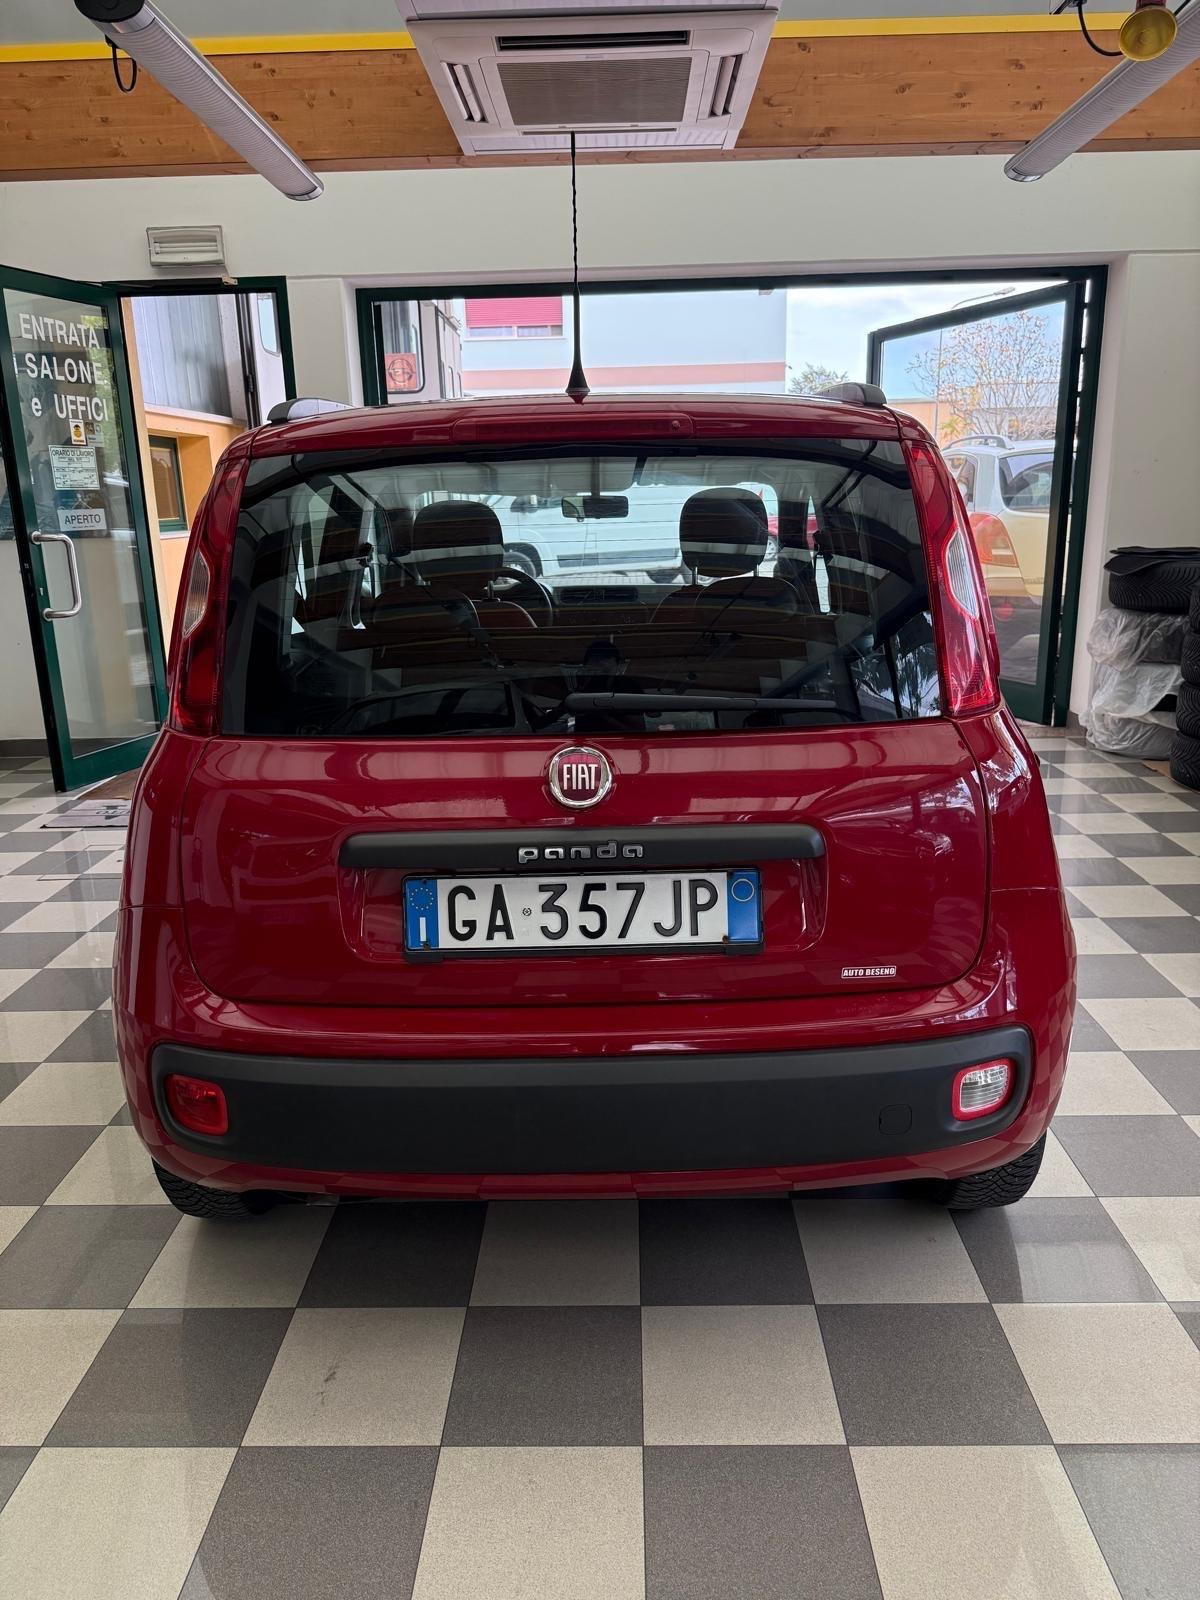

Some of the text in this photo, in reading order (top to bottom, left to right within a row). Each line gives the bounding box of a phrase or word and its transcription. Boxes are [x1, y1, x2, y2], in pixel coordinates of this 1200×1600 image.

[19, 313, 100, 349] ENTRATA
[25, 352, 104, 385] SALONE
[31, 394, 108, 421] e UFFICI
[65, 513, 101, 525] APERTO
[563, 763, 598, 790] FIAT
[518, 840, 643, 864] panda
[865, 968, 895, 976] BESENO
